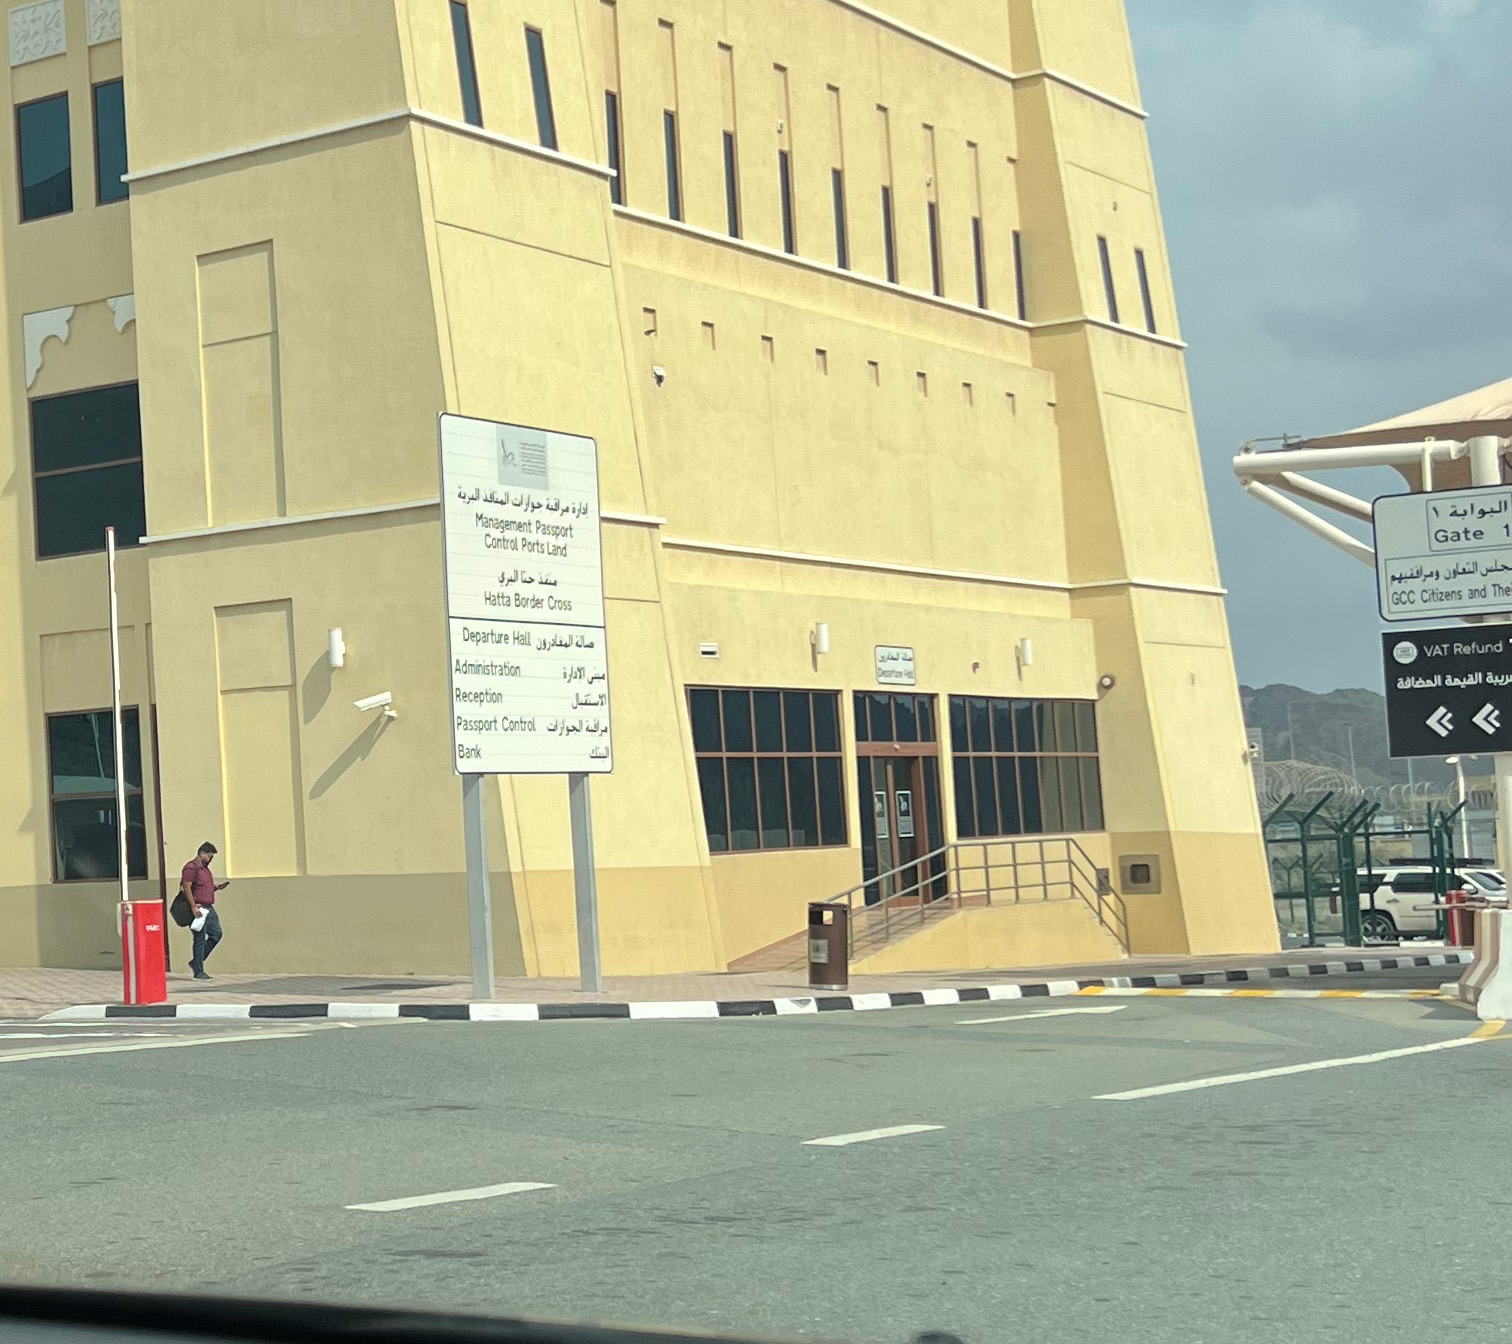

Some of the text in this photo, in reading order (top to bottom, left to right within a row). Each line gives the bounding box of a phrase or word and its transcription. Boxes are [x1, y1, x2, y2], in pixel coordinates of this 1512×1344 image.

[457, 485, 479, 505] البرية
[483, 489, 510, 506] المنافذ
[512, 494, 543, 513] جوازات
[545, 497, 570, 517] مراقبة
[1449, 499, 1508, 521] البوابة
[475, 513, 574, 540] Management Passport
[1434, 523, 1510, 544] Gate 1
[484, 533, 568, 558] Control Ports Land
[498, 570, 518, 587] البري
[537, 572, 557, 586] منفذ
[1390, 559, 1512, 585] جلس التعاون ومرافقيهم
[484, 590, 573, 612] Hatta Border Cross
[1391, 590, 1416, 605] GCC
[1421, 588, 1463, 603] Citizens
[1468, 584, 1487, 599] and
[463, 627, 531, 647] Departure Hall
[536, 634, 595, 651] صالة المغادرون
[1423, 643, 1450, 657] VAT
[1453, 640, 1503, 656] Refund
[454, 658, 521, 677] Administration
[1396, 672, 1512, 689] ريبة القيمة المضافة
[455, 687, 503, 707] Reception
[456, 716, 537, 735] Passport Control
[547, 719, 608, 736] مراقبة الجوازات
[457, 743, 481, 759] Bank
[589, 746, 609, 763] البنك
